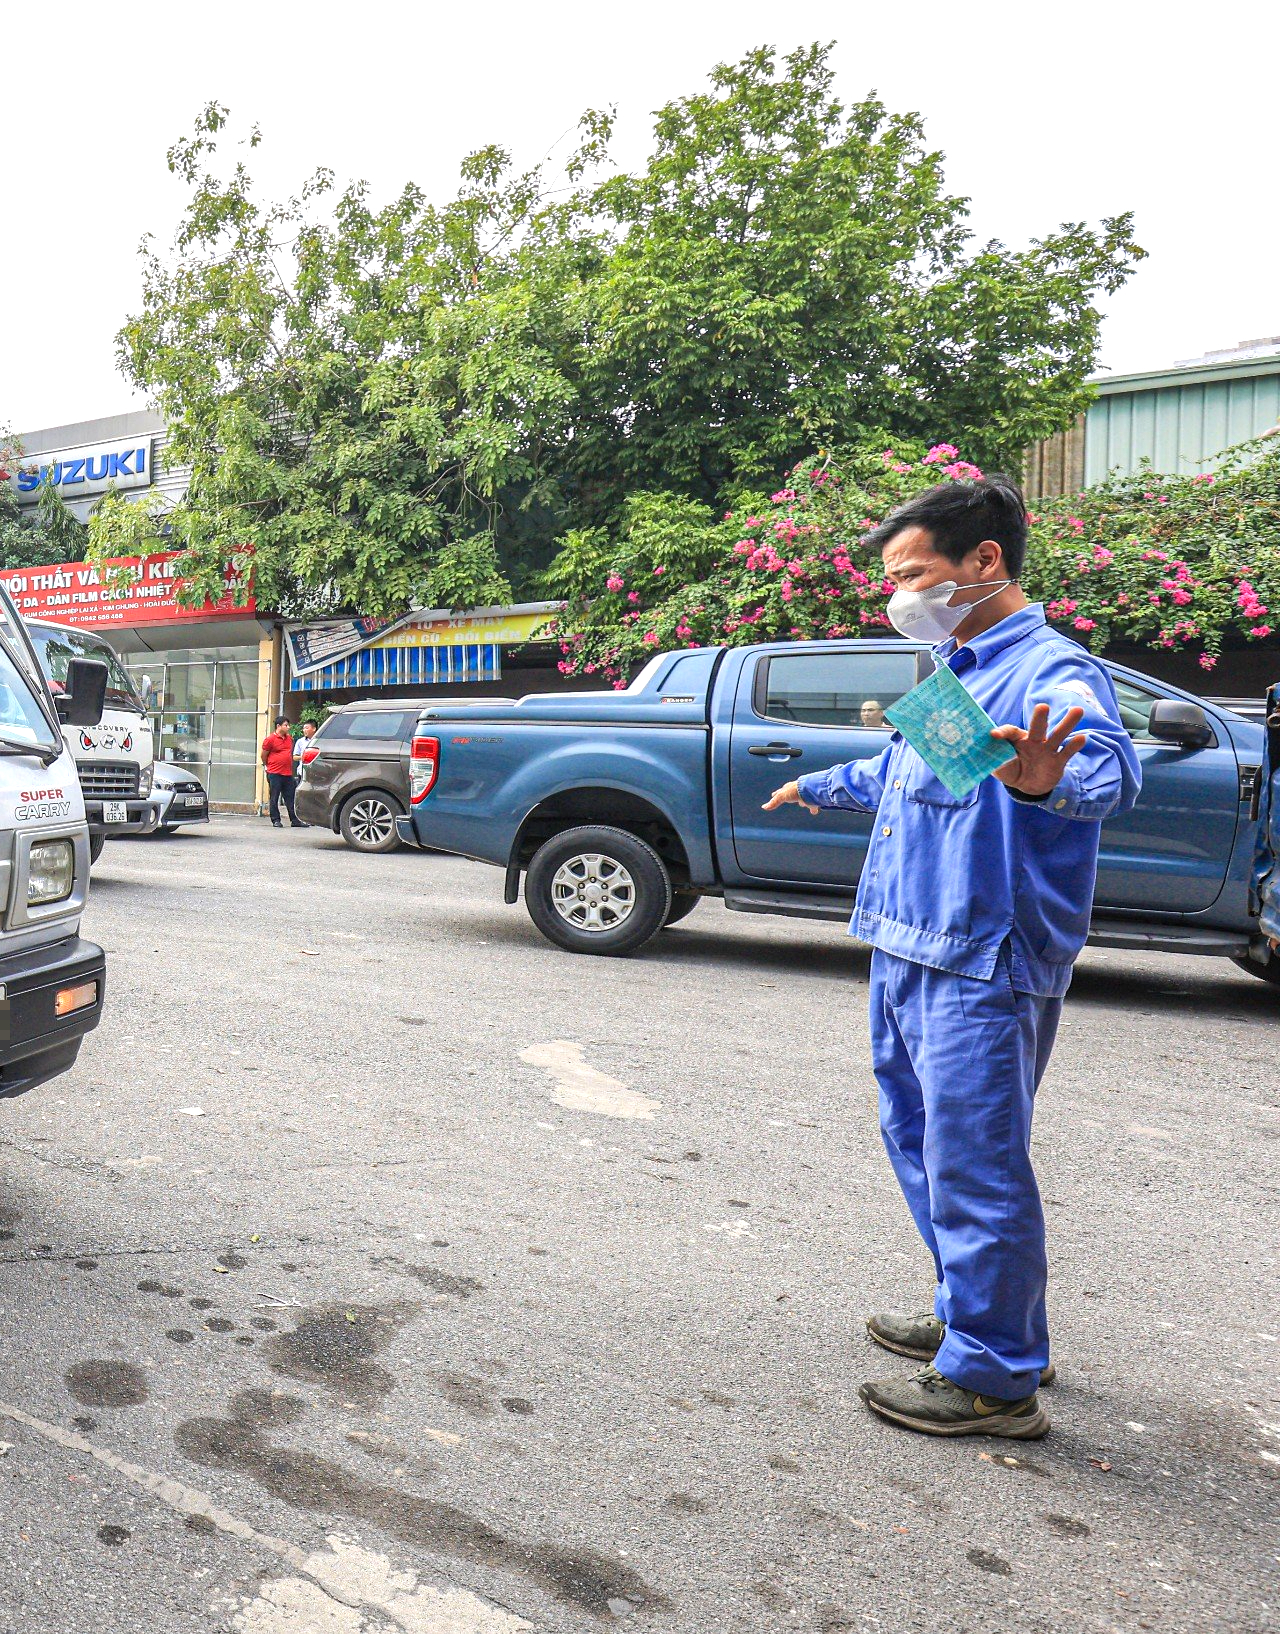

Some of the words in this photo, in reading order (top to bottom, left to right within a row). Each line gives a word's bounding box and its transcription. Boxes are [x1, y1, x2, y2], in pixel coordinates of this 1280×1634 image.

[17, 448, 146, 492] SUZUKI
[31, 566, 74, 591] THẤT
[77, 565, 100, 587] VÀ
[23, 597, 39, 608] DA
[46, 591, 70, 606] DÁN
[71, 591, 98, 603] FILM
[136, 582, 172, 598] NHIỆT
[20, 788, 64, 803] SUPER
[14, 801, 71, 821] CARRY
